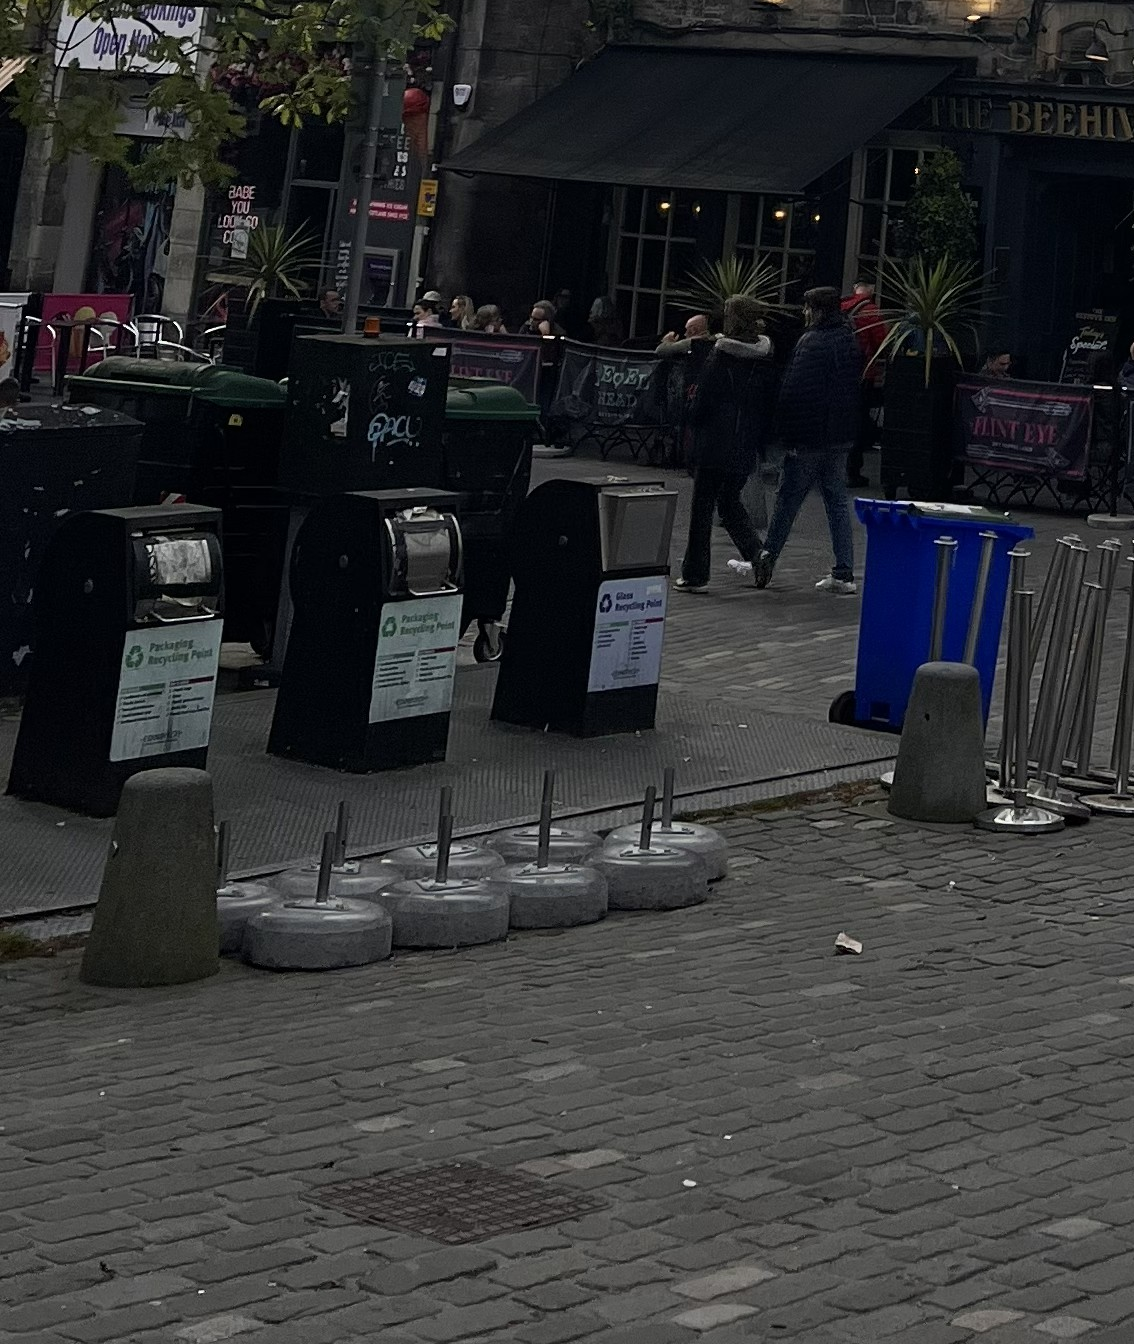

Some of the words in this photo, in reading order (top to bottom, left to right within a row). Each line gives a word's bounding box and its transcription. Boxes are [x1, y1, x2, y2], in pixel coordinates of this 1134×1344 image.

[134, 1, 197, 29] ookings
[94, 27, 127, 61] Open
[924, 95, 993, 130] THE
[229, 185, 257, 200] BABE
[232, 200, 251, 214] YOU
[971, 415, 1020, 441] FLINT
[1023, 422, 1058, 445] EYE
[615, 601, 645, 612] Recycling
[646, 599, 663, 609] Point
[402, 612, 440, 624] Packaging
[400, 624, 435, 637] Recycling
[436, 621, 455, 631] Point
[149, 639, 194, 652] Packaging
[147, 651, 190, 667] Recycling
[190, 647, 213, 660] Point
